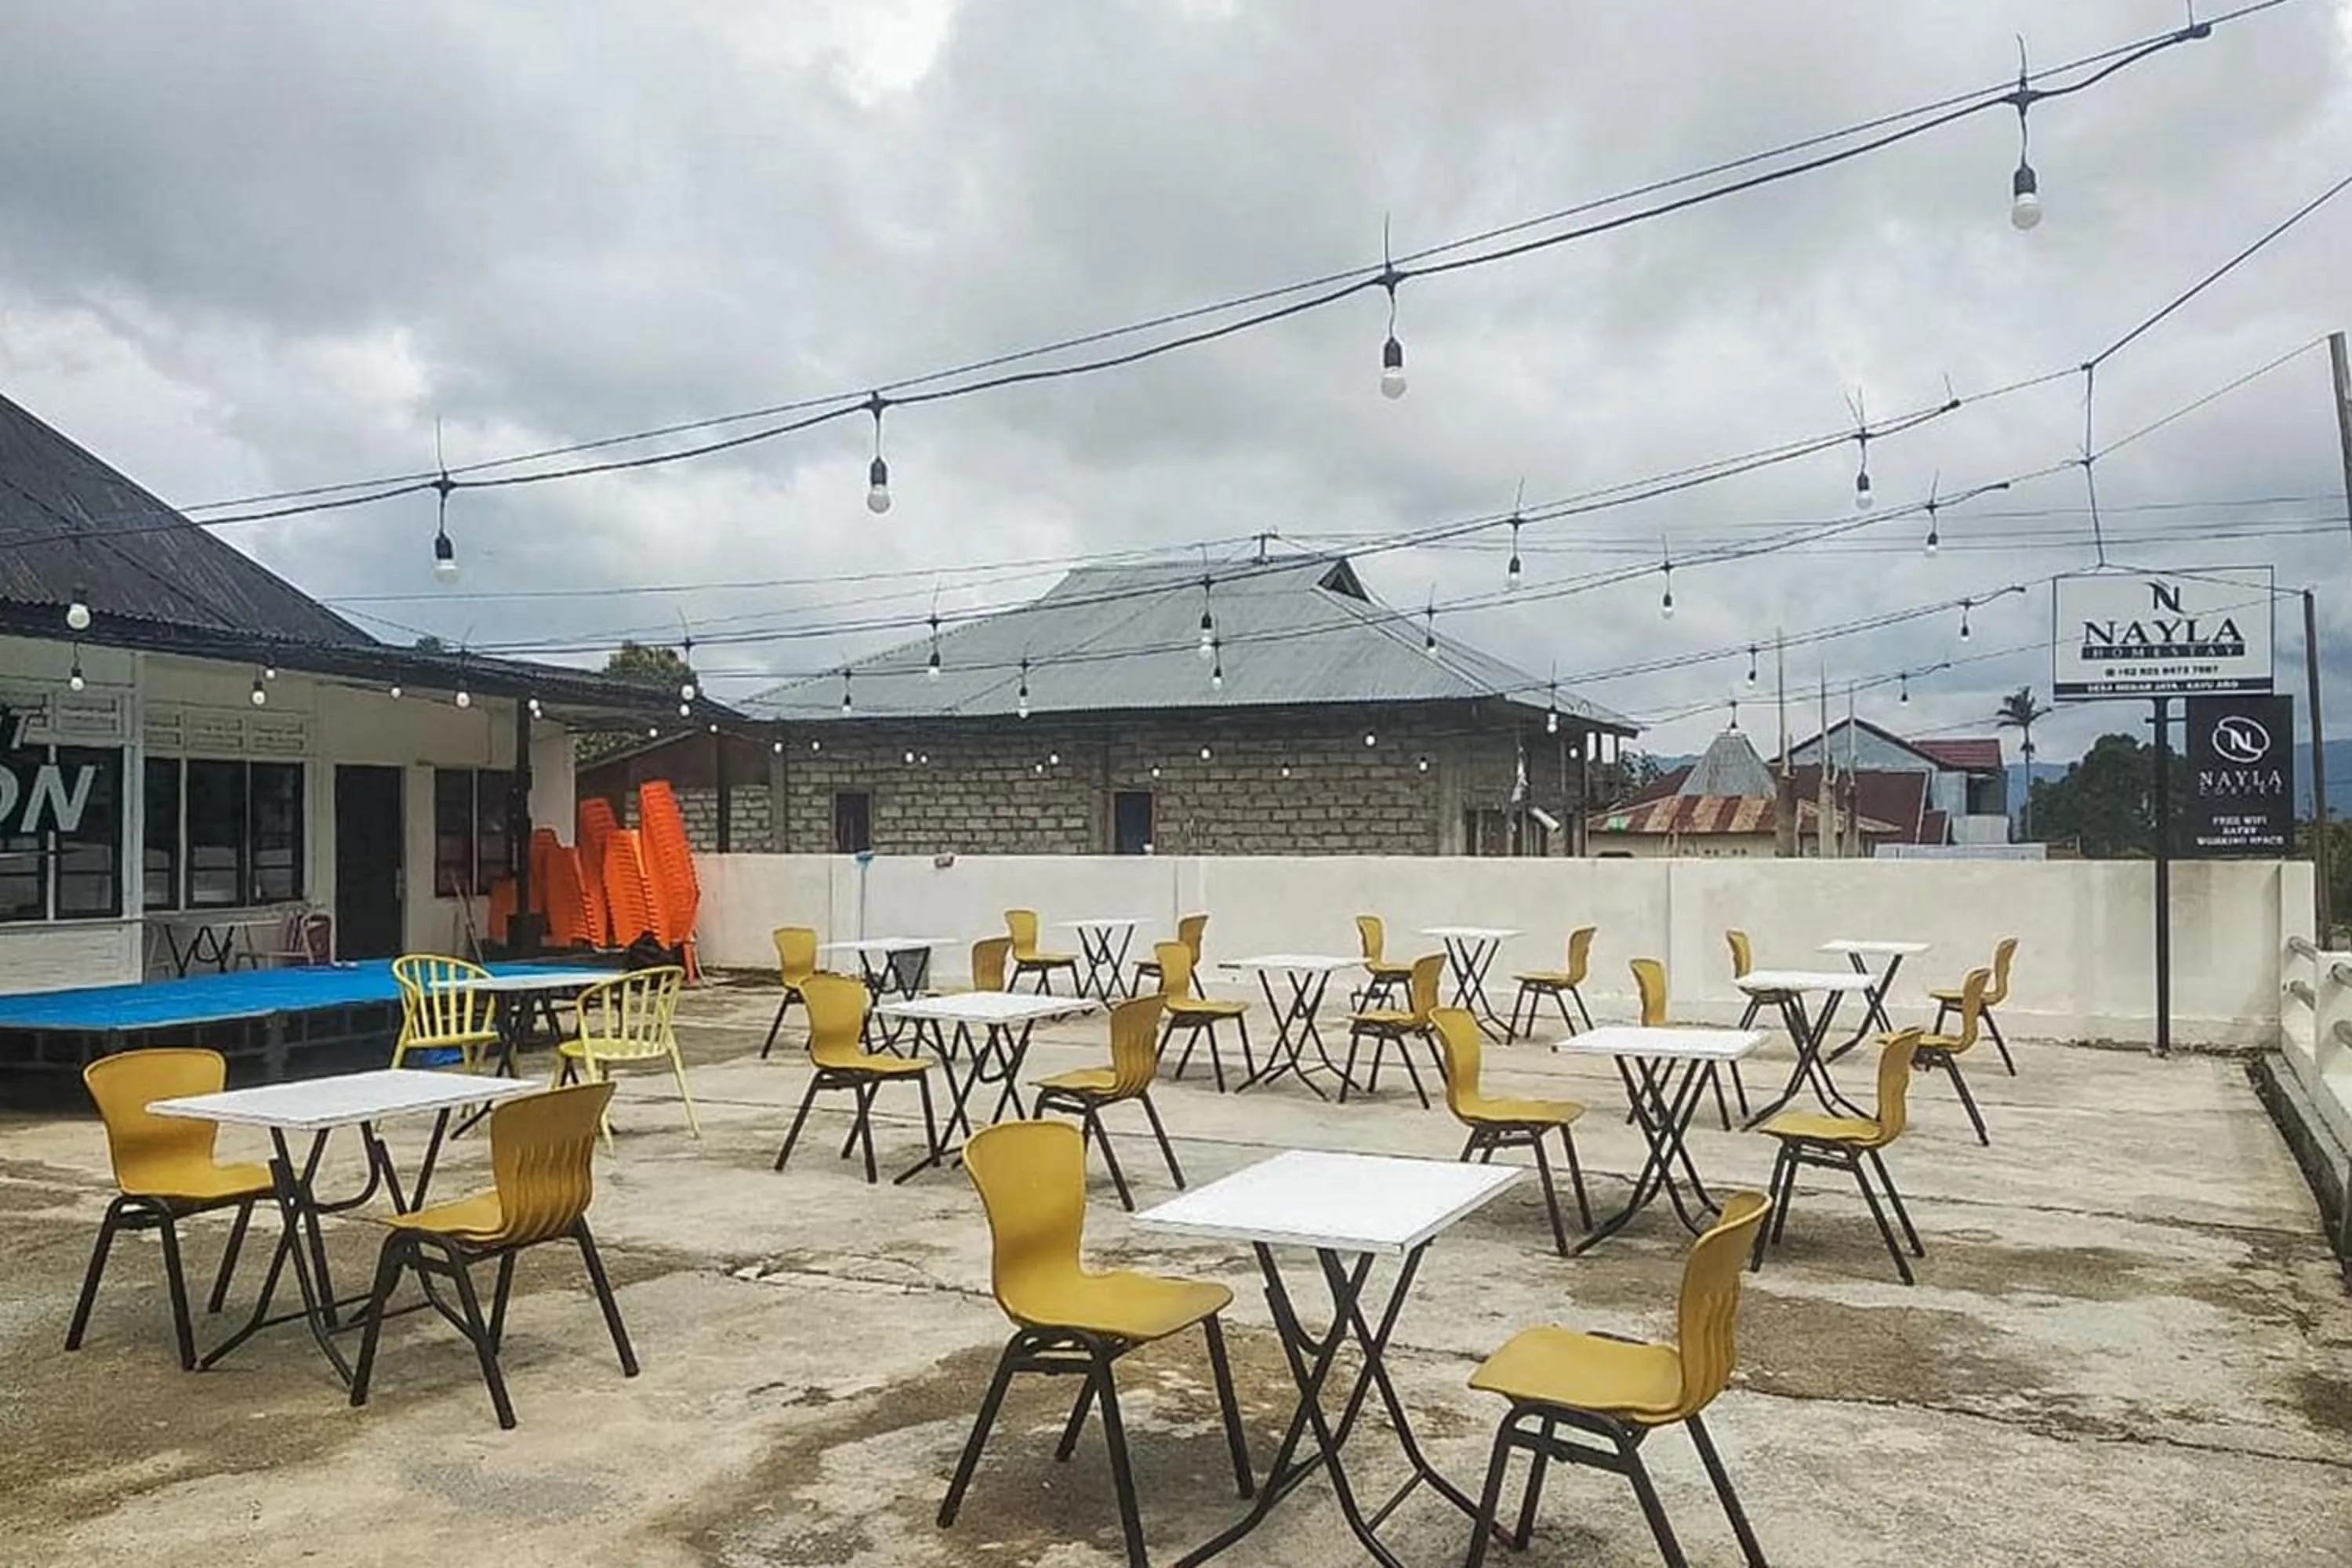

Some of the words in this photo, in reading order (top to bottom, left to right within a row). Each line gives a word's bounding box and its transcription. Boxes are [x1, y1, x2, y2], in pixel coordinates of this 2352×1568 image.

[2082, 618, 2244, 645] NAYLA
[2092, 647, 2235, 658] HOMESTAY
[2198, 769, 2282, 786] NAYLA
[2212, 816, 2241, 826] FREE
[2243, 815, 2267, 826] WIFI
[2196, 836, 2247, 846] WORKING
[2249, 835, 2285, 845] SPACE
